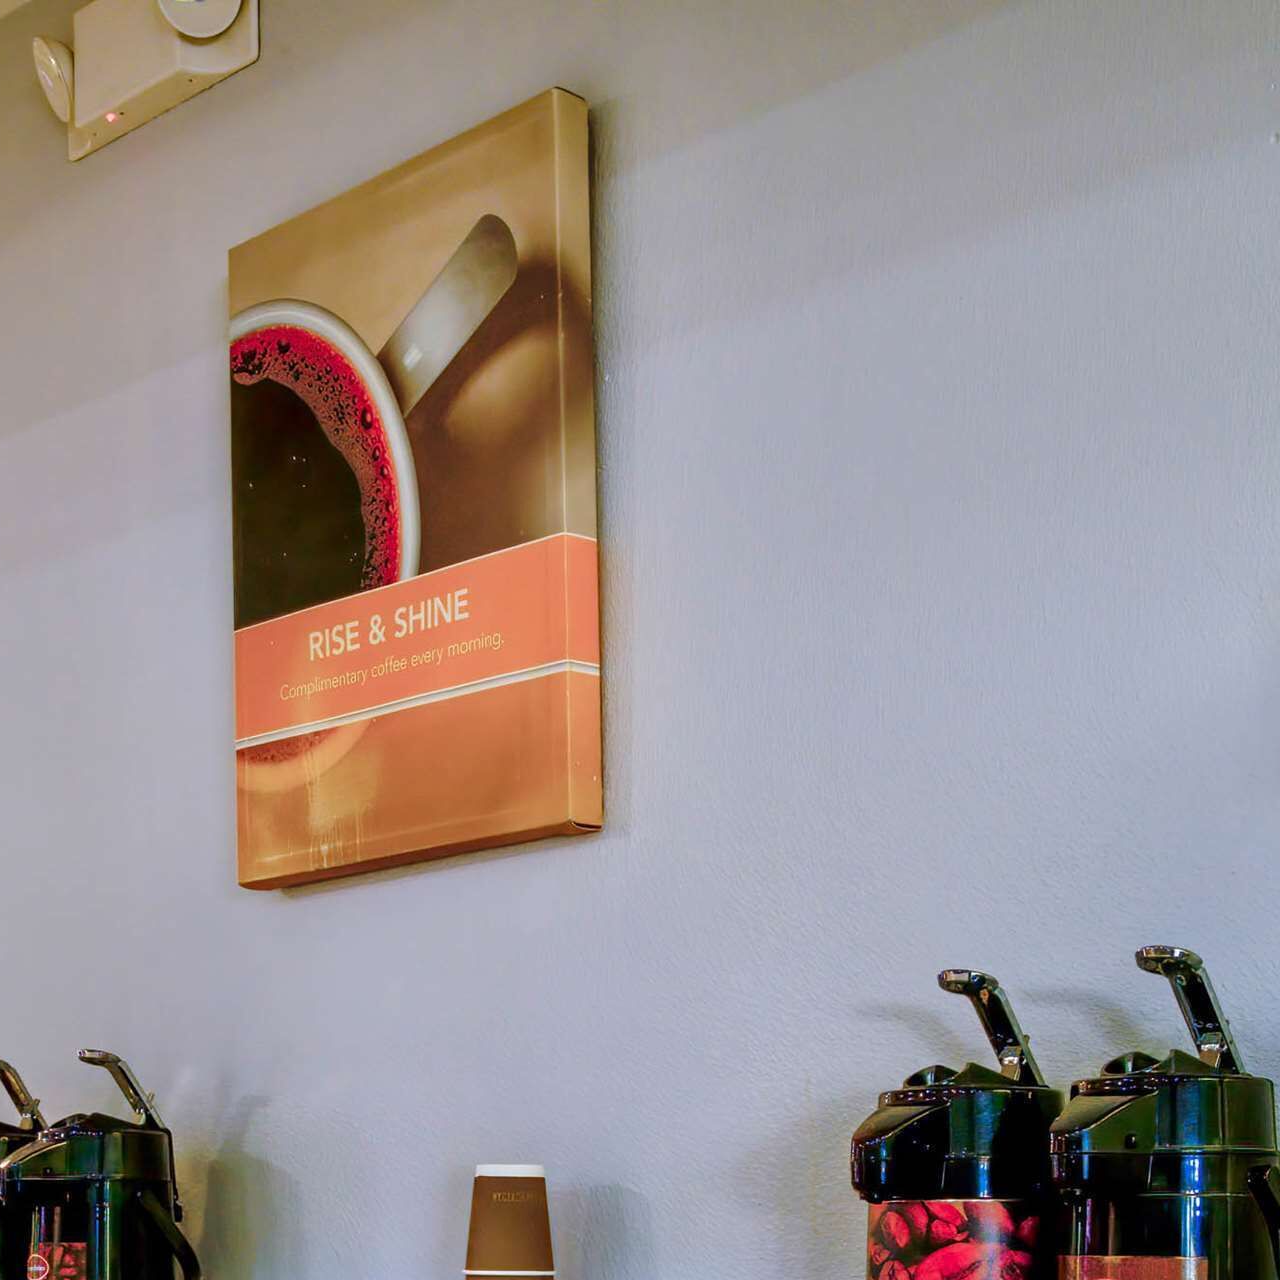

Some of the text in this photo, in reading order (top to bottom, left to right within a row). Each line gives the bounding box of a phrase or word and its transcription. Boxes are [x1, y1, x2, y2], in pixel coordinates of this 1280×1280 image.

[308, 588, 470, 661] RISE & SHINE
[279, 667, 368, 701] Complimentary
[371, 657, 408, 679] coffee
[410, 649, 443, 670] every
